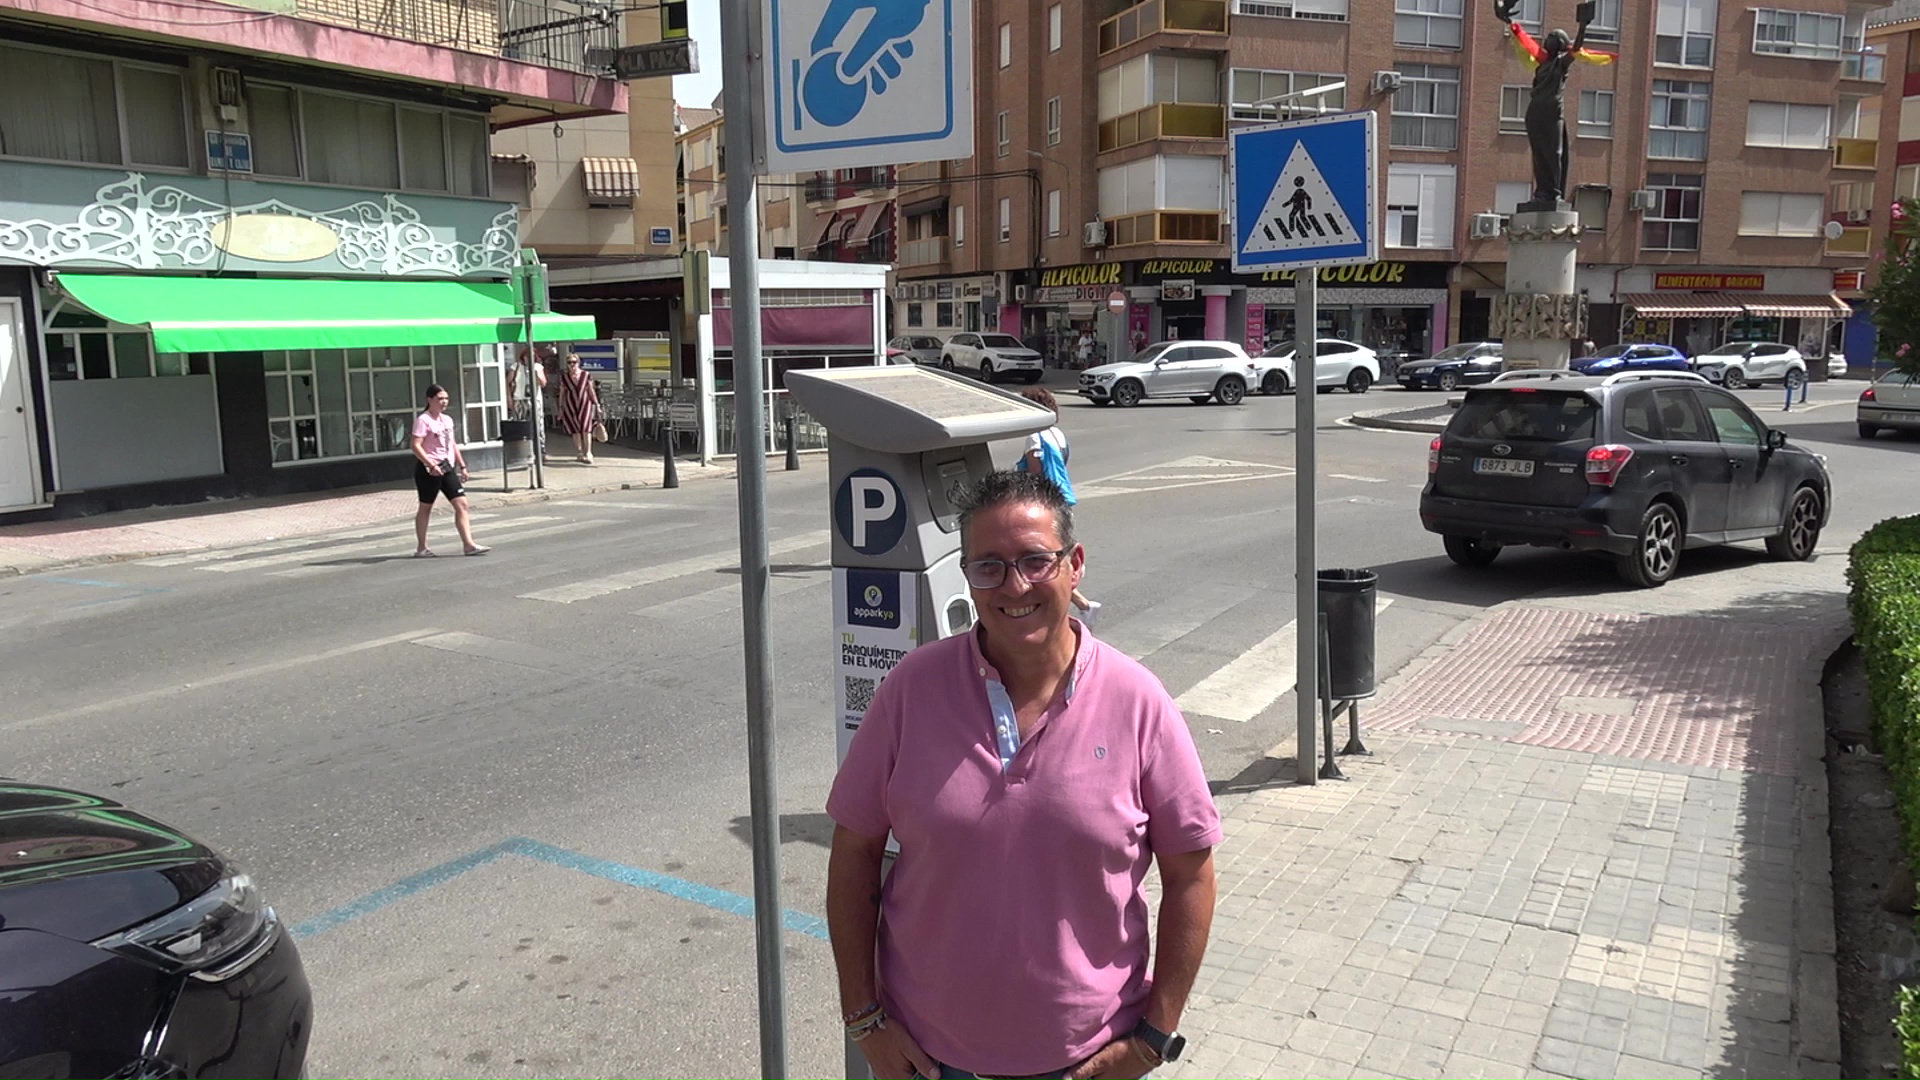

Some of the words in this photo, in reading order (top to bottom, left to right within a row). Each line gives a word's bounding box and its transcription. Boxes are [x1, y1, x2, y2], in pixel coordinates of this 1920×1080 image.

[627, 53, 646, 71] LA
[649, 49, 677, 70] PAZ
[1041, 262, 1122, 287] ALPICOLOR
[1142, 260, 1213, 274] ALPICOLOR
[1261, 262, 1405, 283] LCOLOR
[1076, 285, 1119, 299] DIGIT
[1480, 459, 1507, 472] 6873
[1510, 461, 1532, 473] JLB
[850, 476, 897, 548] P
[853, 607, 894, 621] apparkya
[841, 633, 855, 644] TU
[842, 655, 855, 666] EN
[856, 656, 867, 668] EL
[869, 658, 898, 671] MOVI
